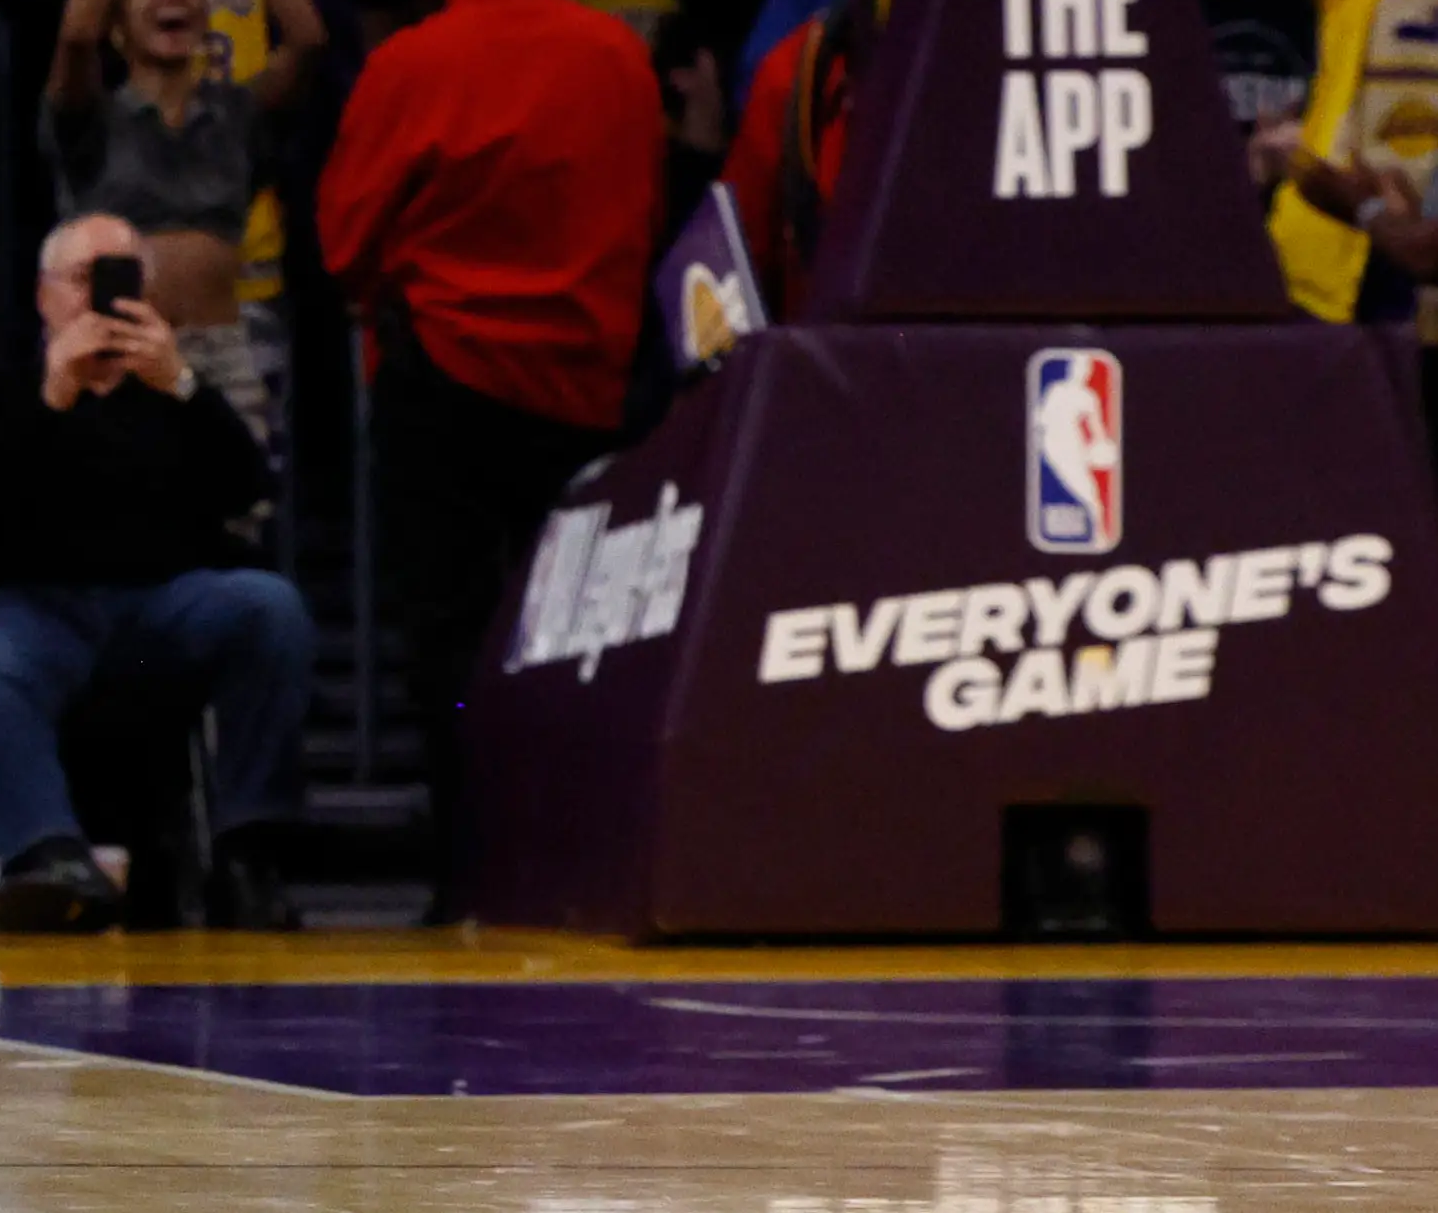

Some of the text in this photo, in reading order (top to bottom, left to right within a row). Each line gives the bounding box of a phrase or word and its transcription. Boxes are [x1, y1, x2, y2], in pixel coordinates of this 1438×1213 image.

[993, 68, 1153, 199] APP
[757, 533, 1394, 684] EVERYONE'S
[923, 629, 1220, 731] GAME
